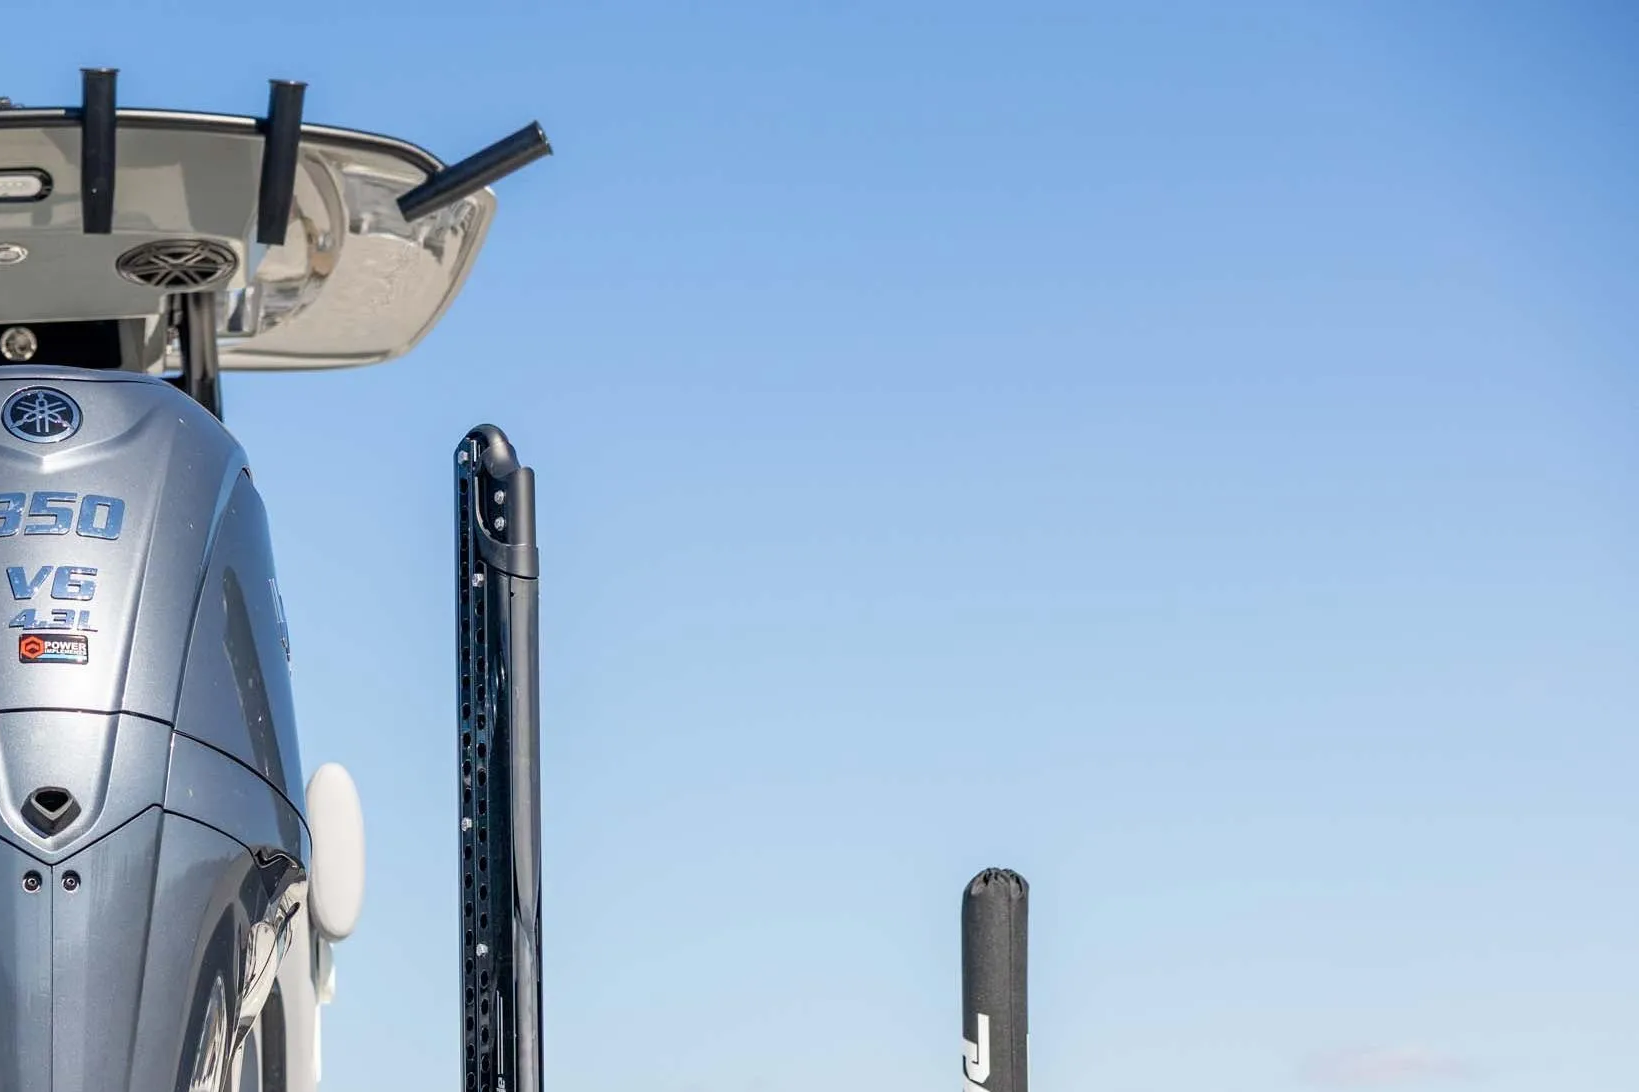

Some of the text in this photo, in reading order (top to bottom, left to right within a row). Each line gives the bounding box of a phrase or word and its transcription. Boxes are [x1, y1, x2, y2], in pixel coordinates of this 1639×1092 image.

[6, 565, 98, 601] V6
[9, 608, 98, 632] 4.3L
[44, 641, 87, 651] POWER
